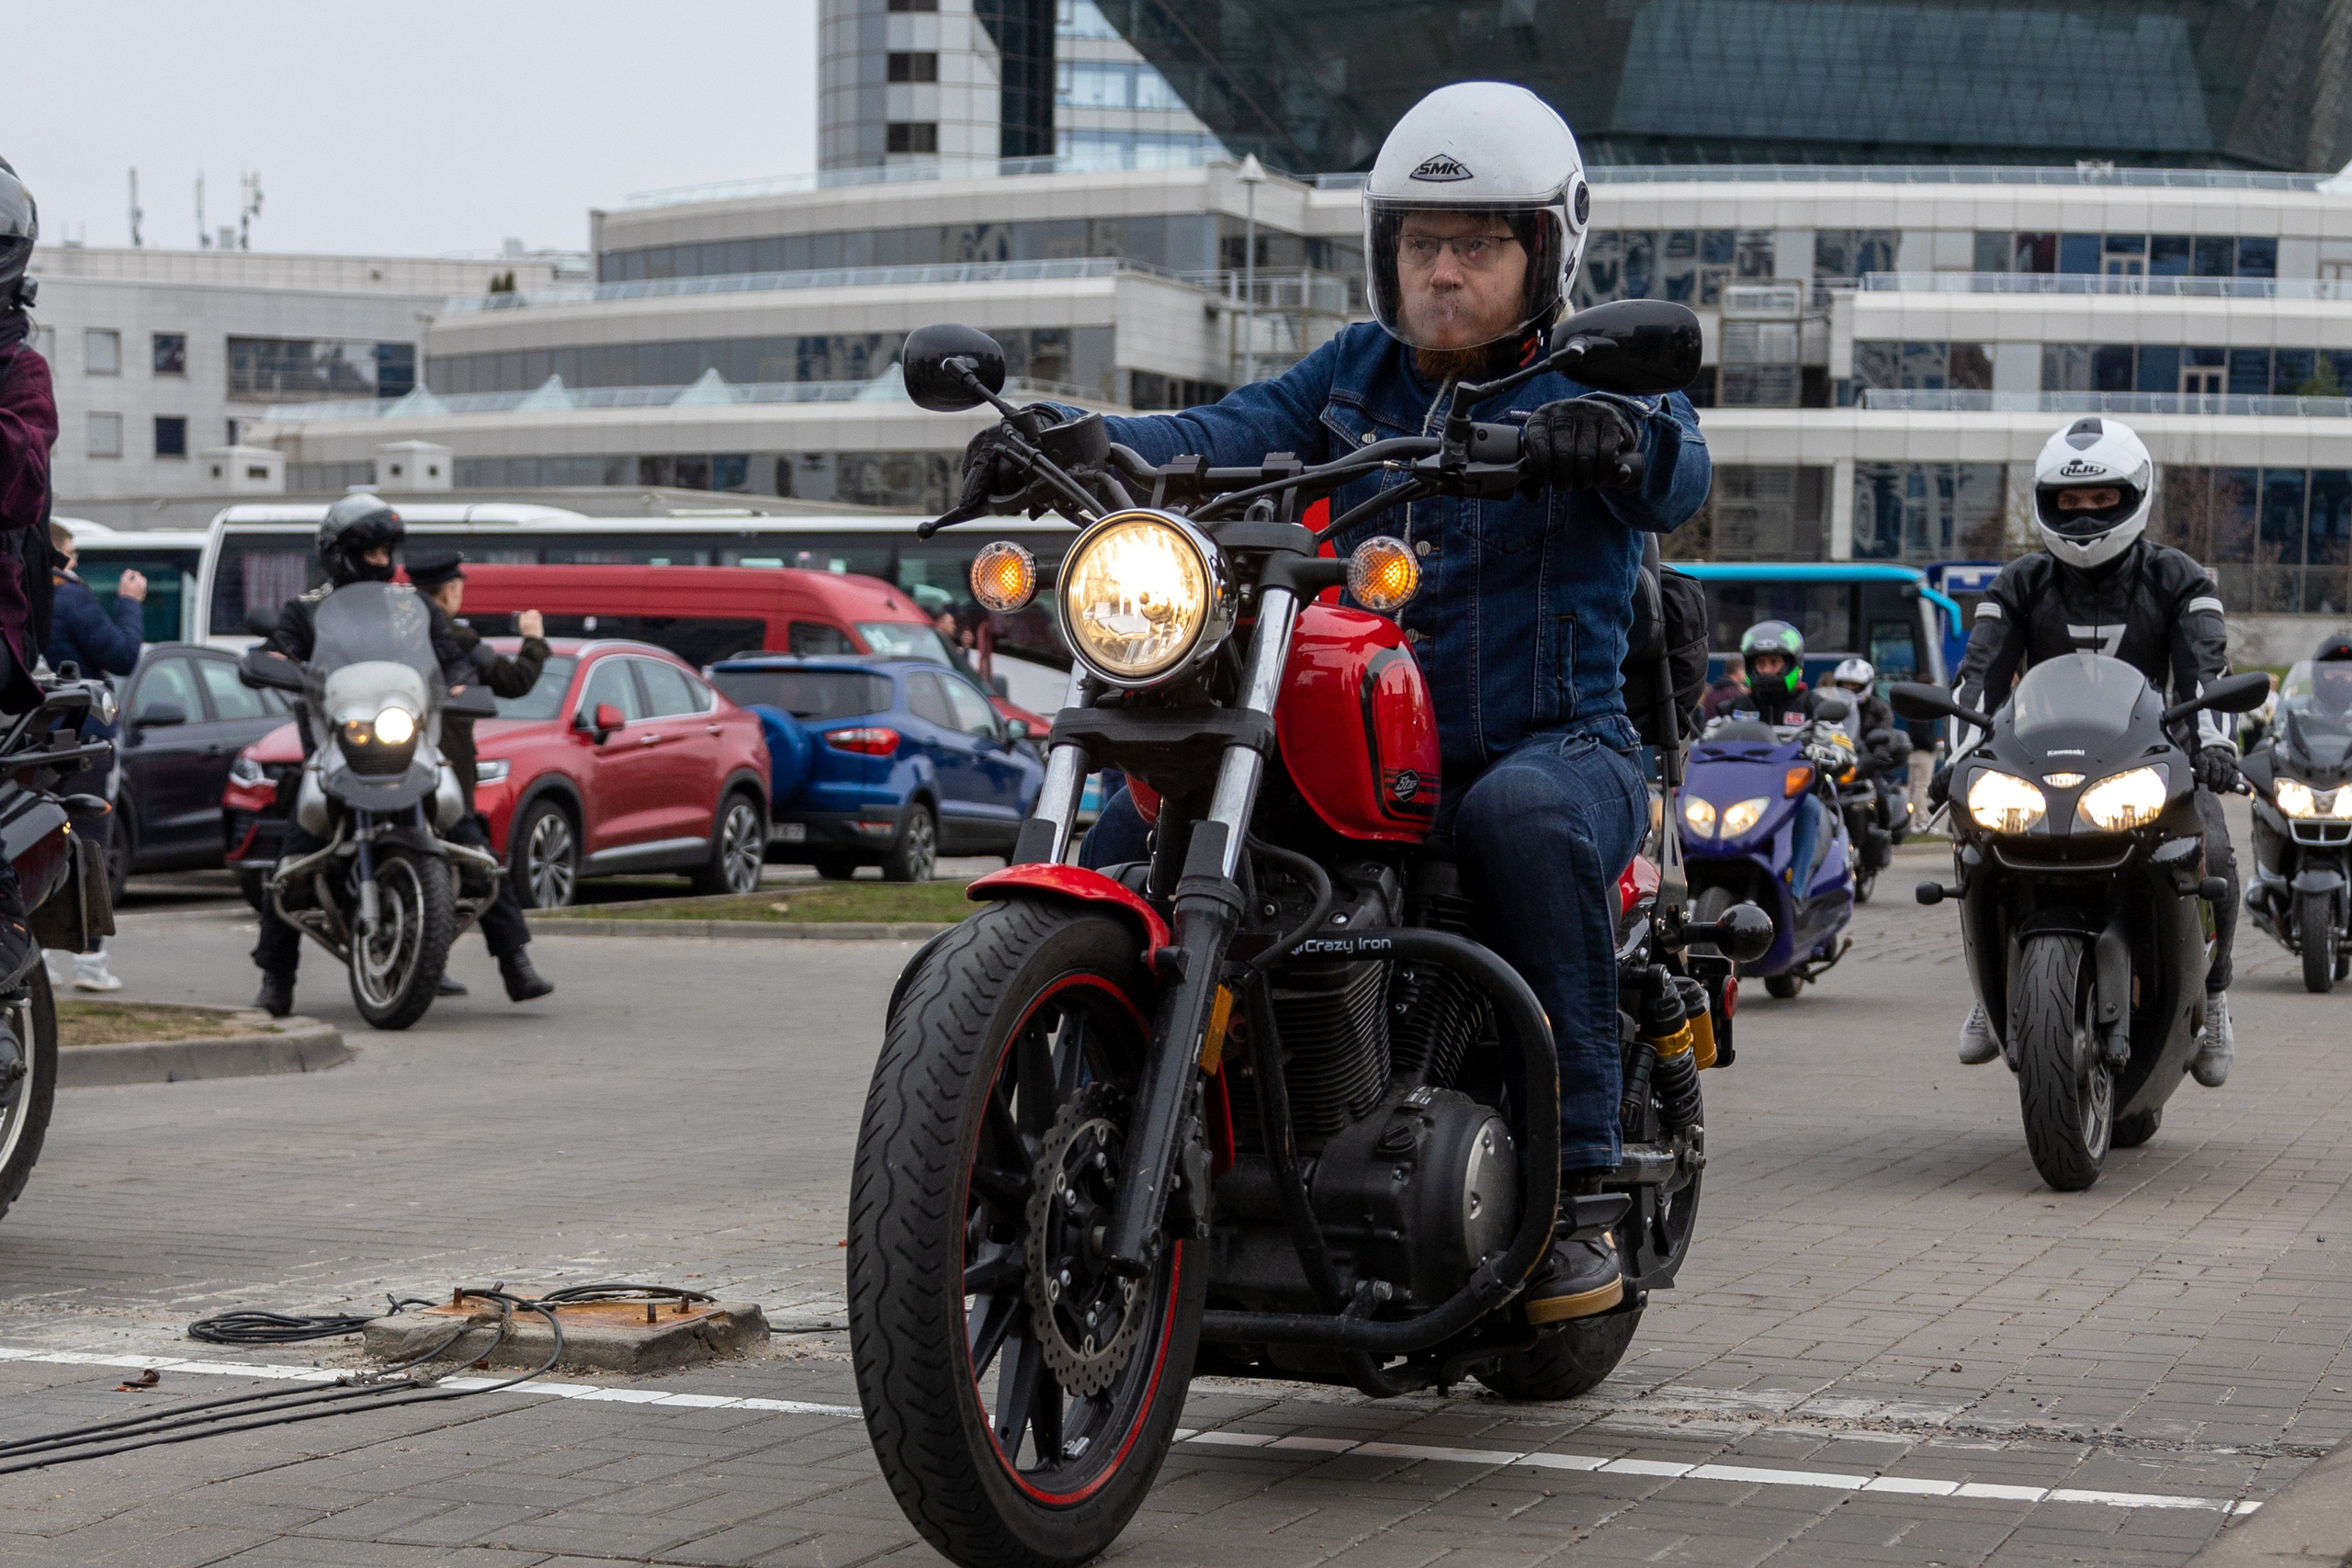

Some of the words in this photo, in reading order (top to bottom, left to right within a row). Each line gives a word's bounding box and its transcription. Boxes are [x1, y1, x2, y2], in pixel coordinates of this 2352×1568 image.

[1418, 163, 1464, 175] SMK
[2065, 464, 2100, 474] HJC
[1305, 939, 1353, 953] Crazy
[1359, 937, 1392, 950] Iron
